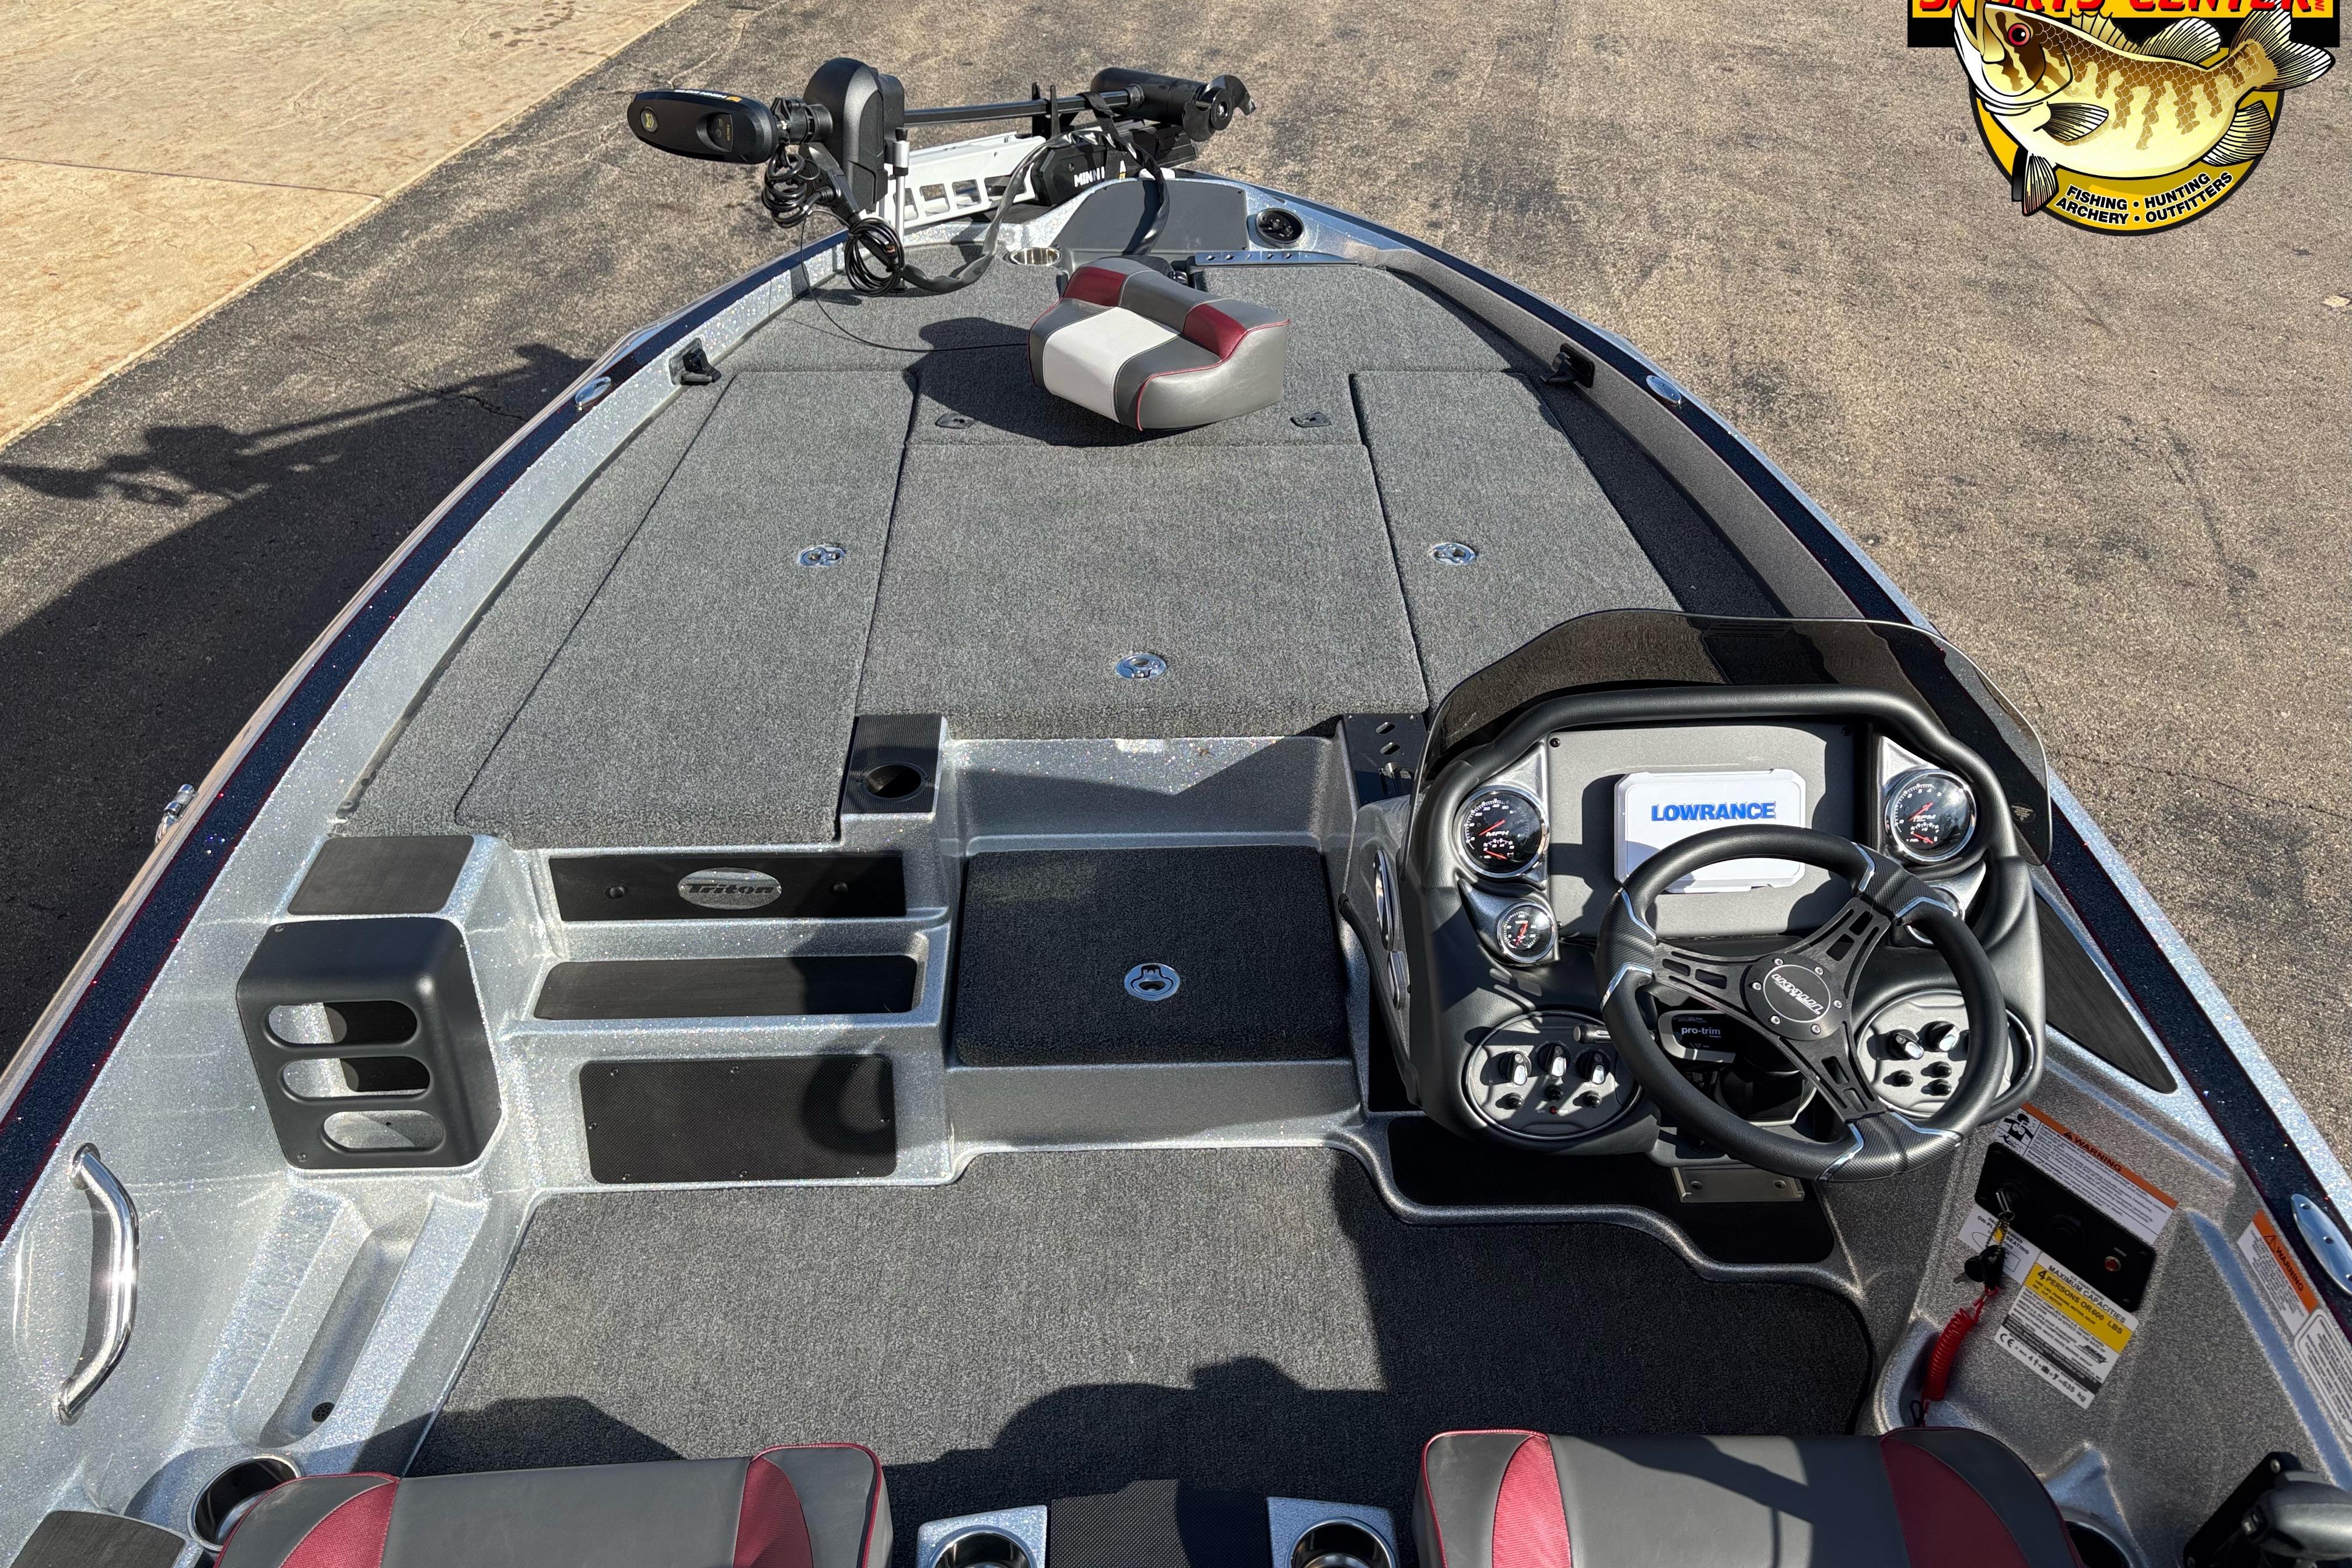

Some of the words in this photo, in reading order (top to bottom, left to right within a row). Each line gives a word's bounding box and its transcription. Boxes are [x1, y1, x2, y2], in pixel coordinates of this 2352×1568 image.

[1651, 802, 1776, 821] LOWRANCE
[685, 884, 774, 894] Triton
[1772, 974, 1824, 1014] Triton
[2074, 1137, 2122, 1172] WARNING
[2004, 1236, 2031, 1255] SEATING
[2276, 1246, 2304, 1292] WARNING
[2037, 1270, 2046, 1280] 4
[2046, 1276, 2080, 1303] PERSONS
[2081, 1298, 2092, 1311] OR
[2092, 1307, 2104, 1321] 600
[2108, 1321, 2123, 1334] LBS
[2049, 1266, 2082, 1293] MAXIMUM
[2083, 1288, 2126, 1323] CAPACITIES
[2077, 1391, 2087, 1402] kg
